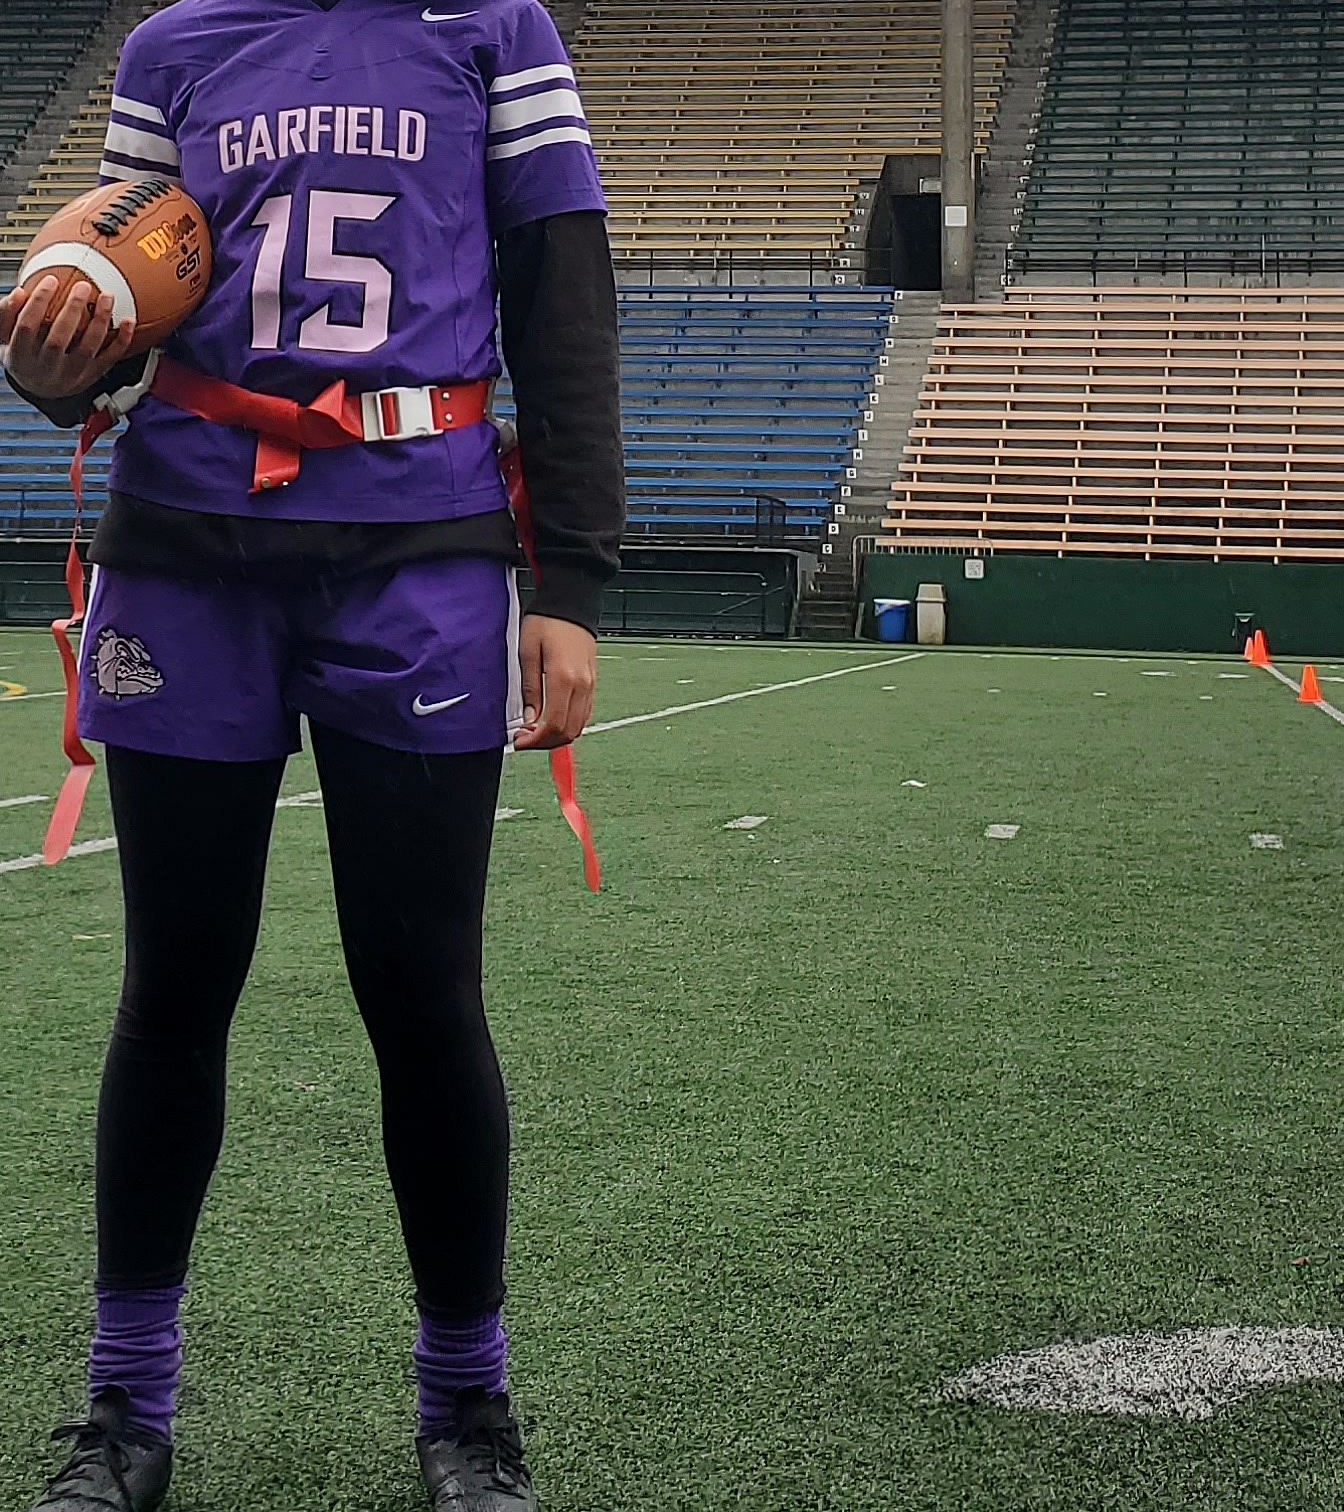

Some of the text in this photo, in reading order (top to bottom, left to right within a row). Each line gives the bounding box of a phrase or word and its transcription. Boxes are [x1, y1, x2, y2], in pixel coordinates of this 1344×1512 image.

[218, 105, 427, 174] GARFIELD
[176, 245, 202, 281] GST
[250, 189, 397, 353] 15
